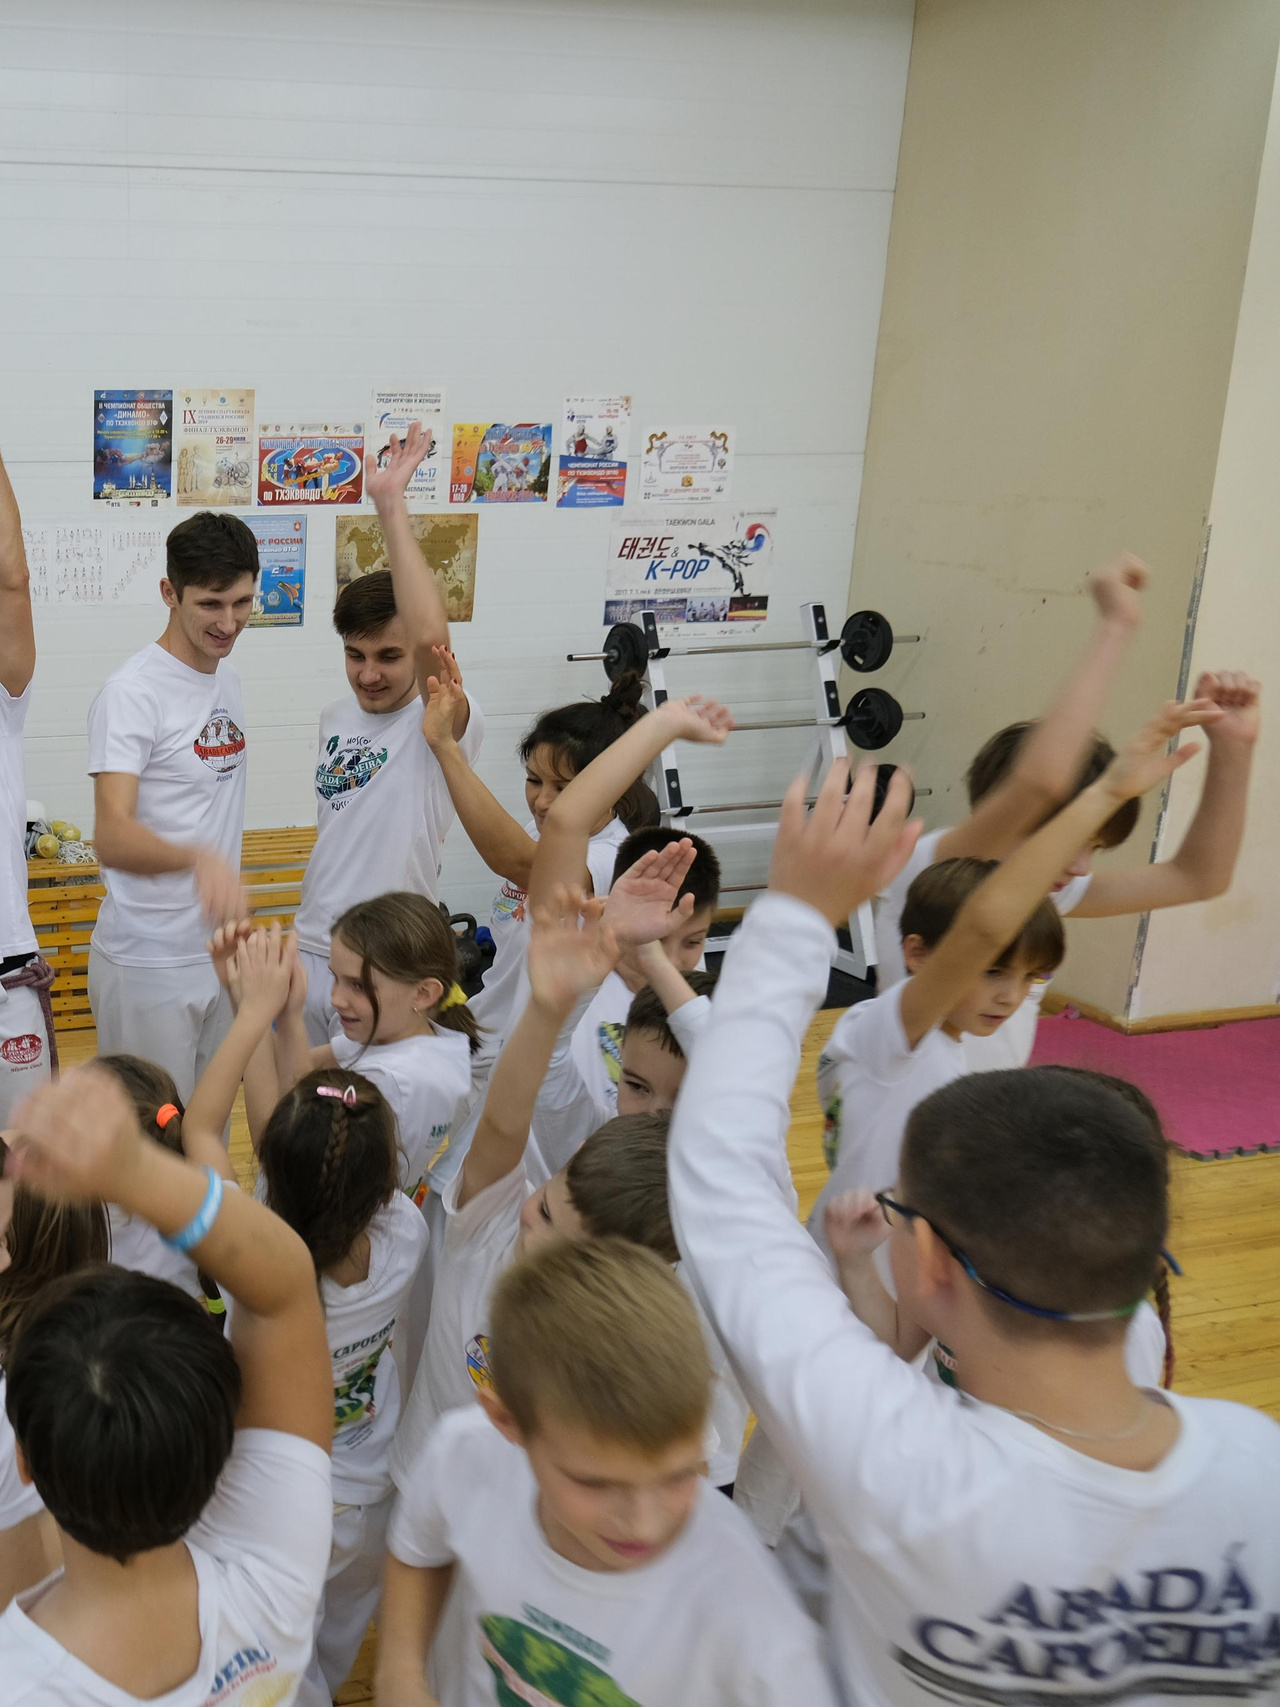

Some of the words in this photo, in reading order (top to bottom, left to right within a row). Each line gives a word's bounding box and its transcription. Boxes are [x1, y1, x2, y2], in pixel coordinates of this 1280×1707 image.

[182, 409, 197, 425] IX
[215, 436, 234, 445] 26-29
[415, 468, 437, 478] 14-17
[275, 488, 321, 502] ТХЭКВОНДО
[268, 537, 303, 545] РОССИИ
[617, 536, 674, 560] 태권도
[671, 547, 680, 558] &
[644, 559, 711, 581] K-POP
[346, 735, 372, 747] MOSCO
[351, 757, 382, 774] OEIRA
[980, 1541, 1257, 1631] ABADÁ
